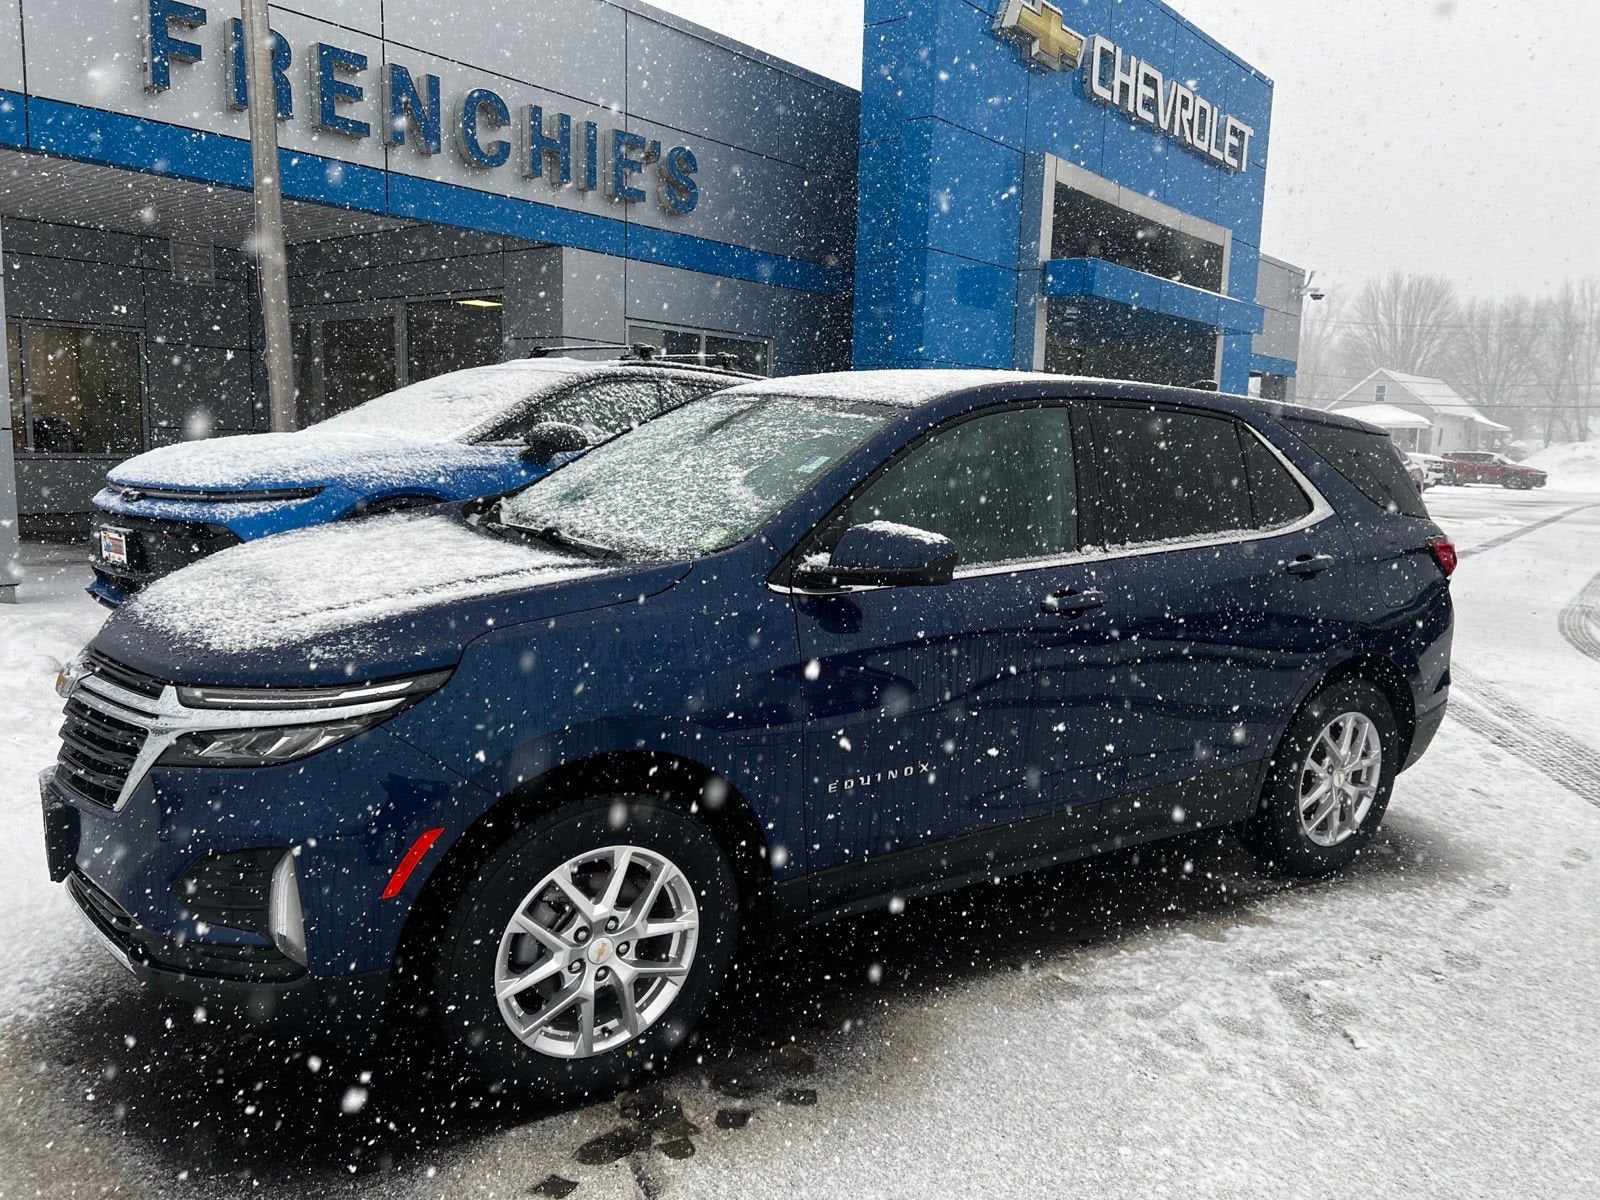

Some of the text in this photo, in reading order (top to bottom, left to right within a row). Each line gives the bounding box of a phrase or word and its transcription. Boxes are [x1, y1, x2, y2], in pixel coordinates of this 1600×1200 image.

[144, 0, 698, 215] FRENCHIE'S
[1090, 34, 1254, 172] CHEVROLET
[828, 761, 929, 793] EQUINOX
